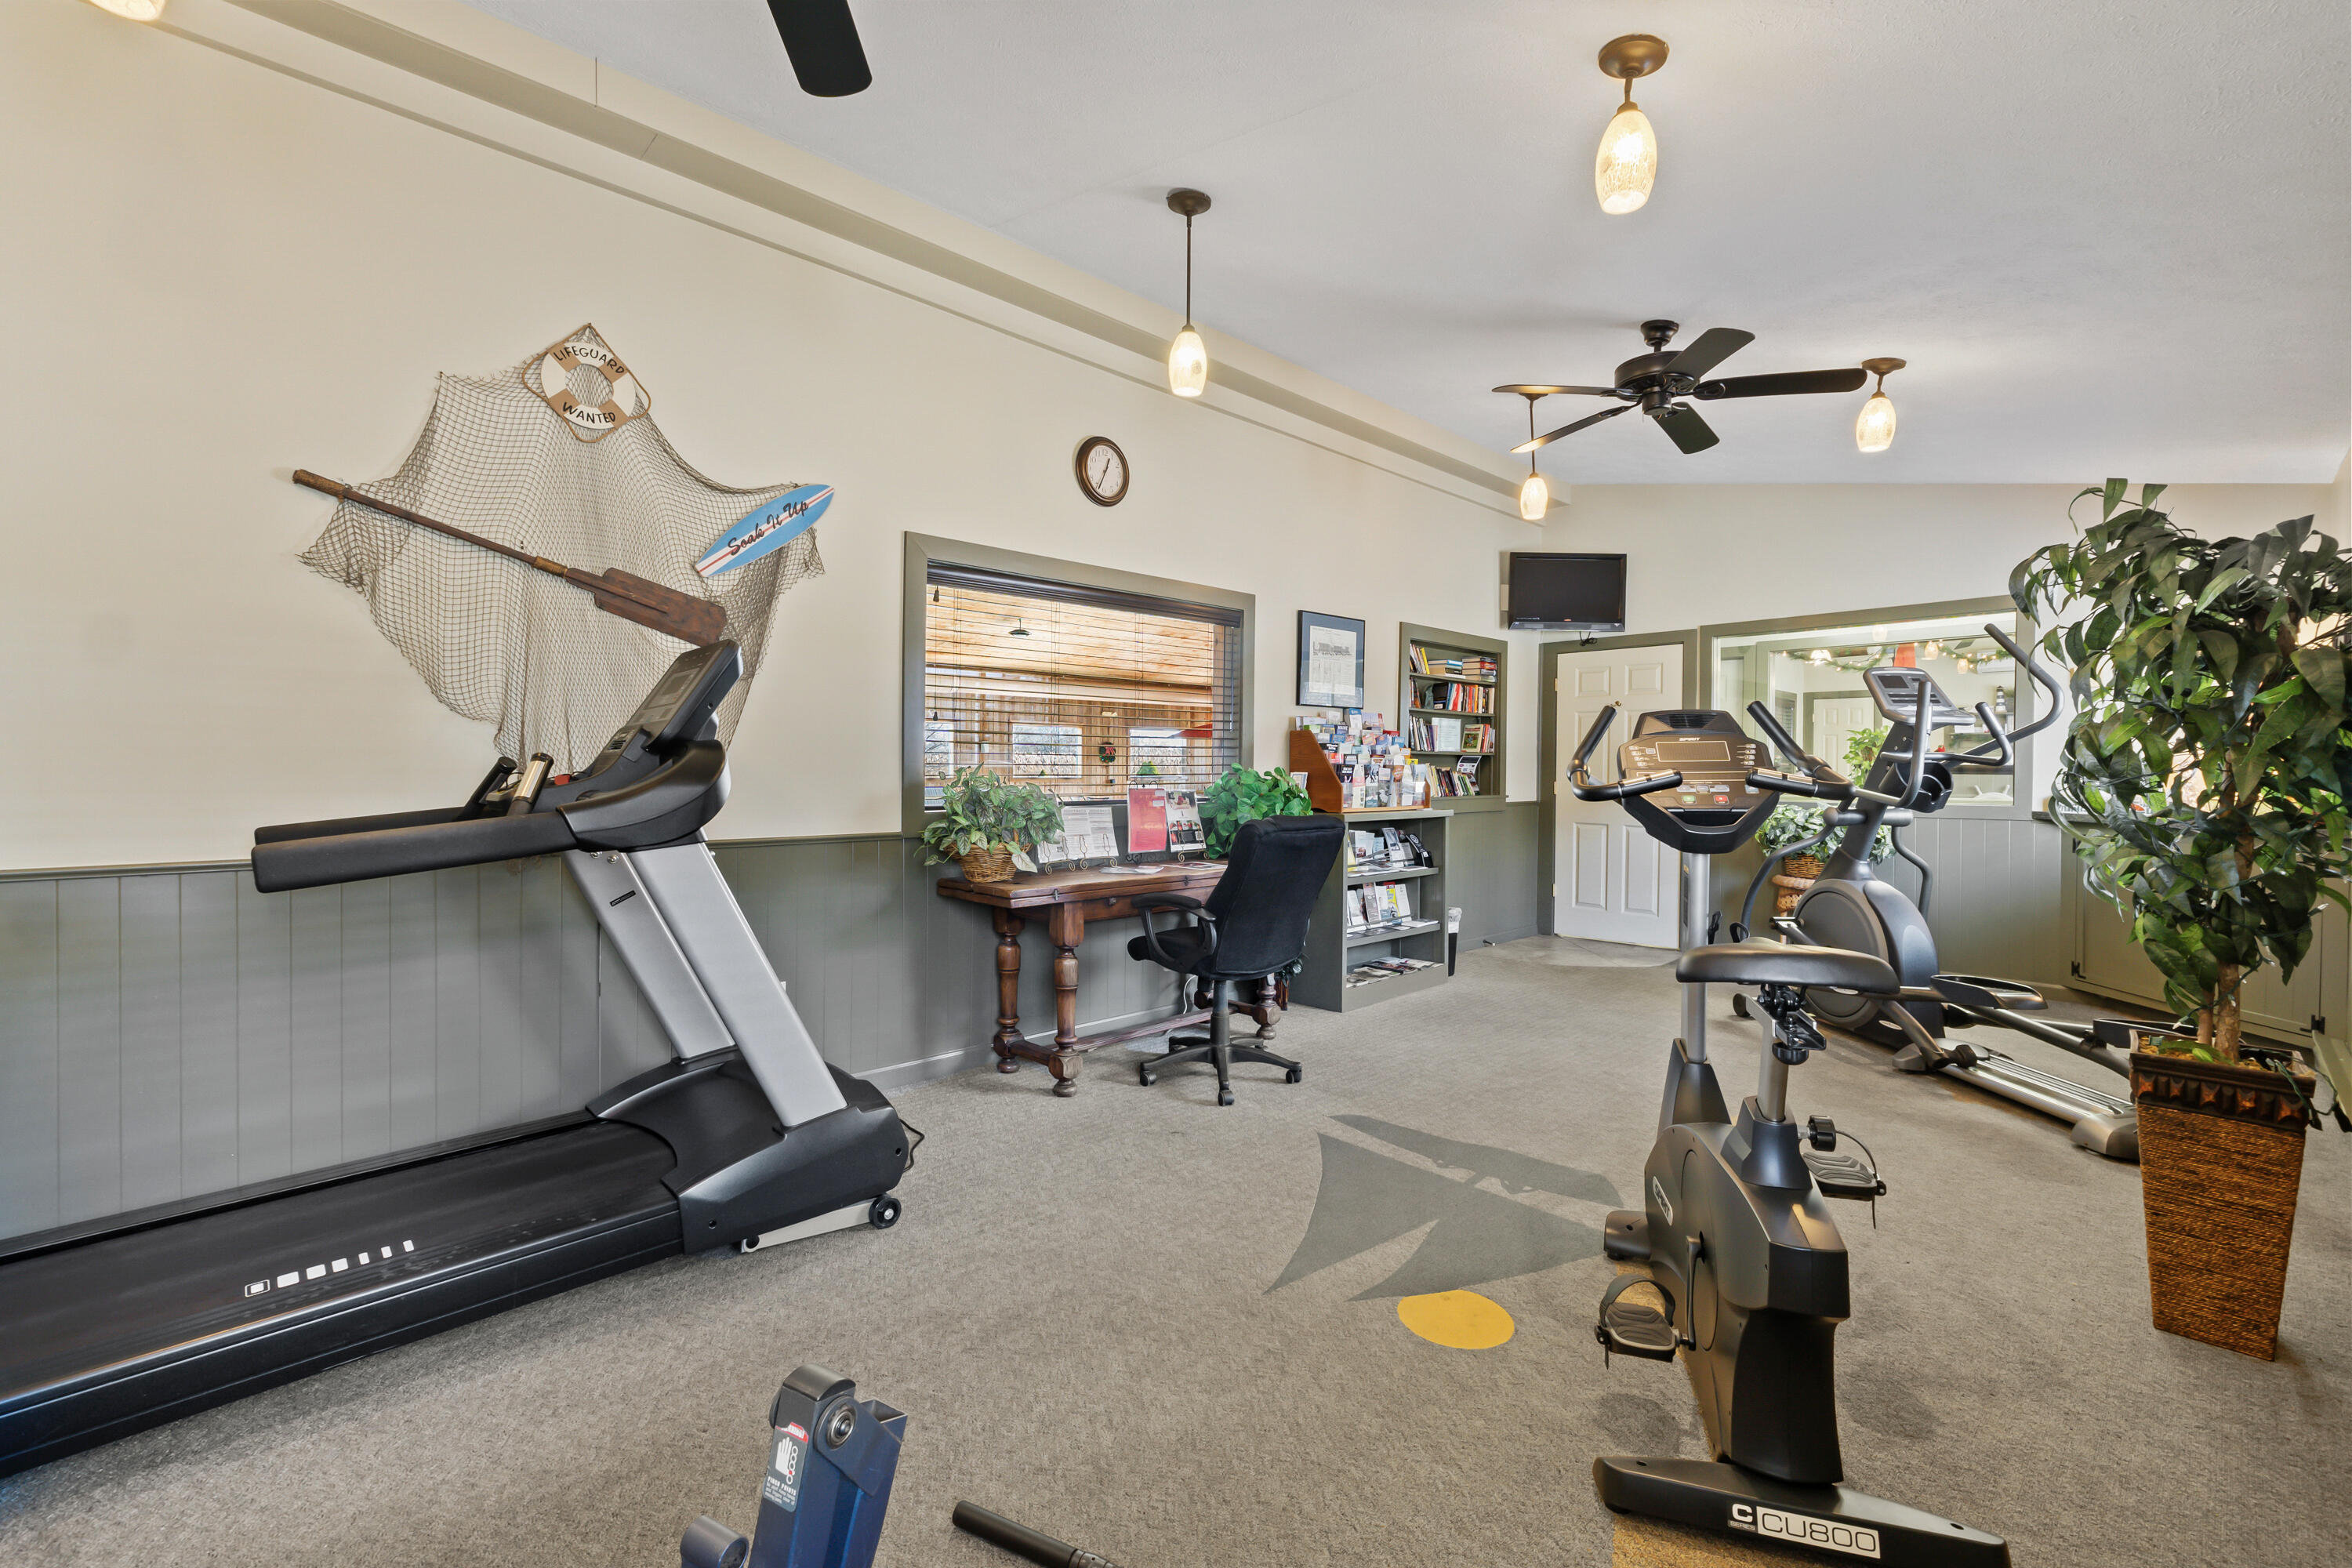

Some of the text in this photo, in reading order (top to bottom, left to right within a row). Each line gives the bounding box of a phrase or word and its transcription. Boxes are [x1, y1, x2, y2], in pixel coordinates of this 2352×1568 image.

[554, 346, 625, 374] LIFEGUARD
[562, 401, 616, 424] WANTED
[728, 501, 809, 556] Soak It Up
[1732, 1503, 1876, 1552] C CU800
